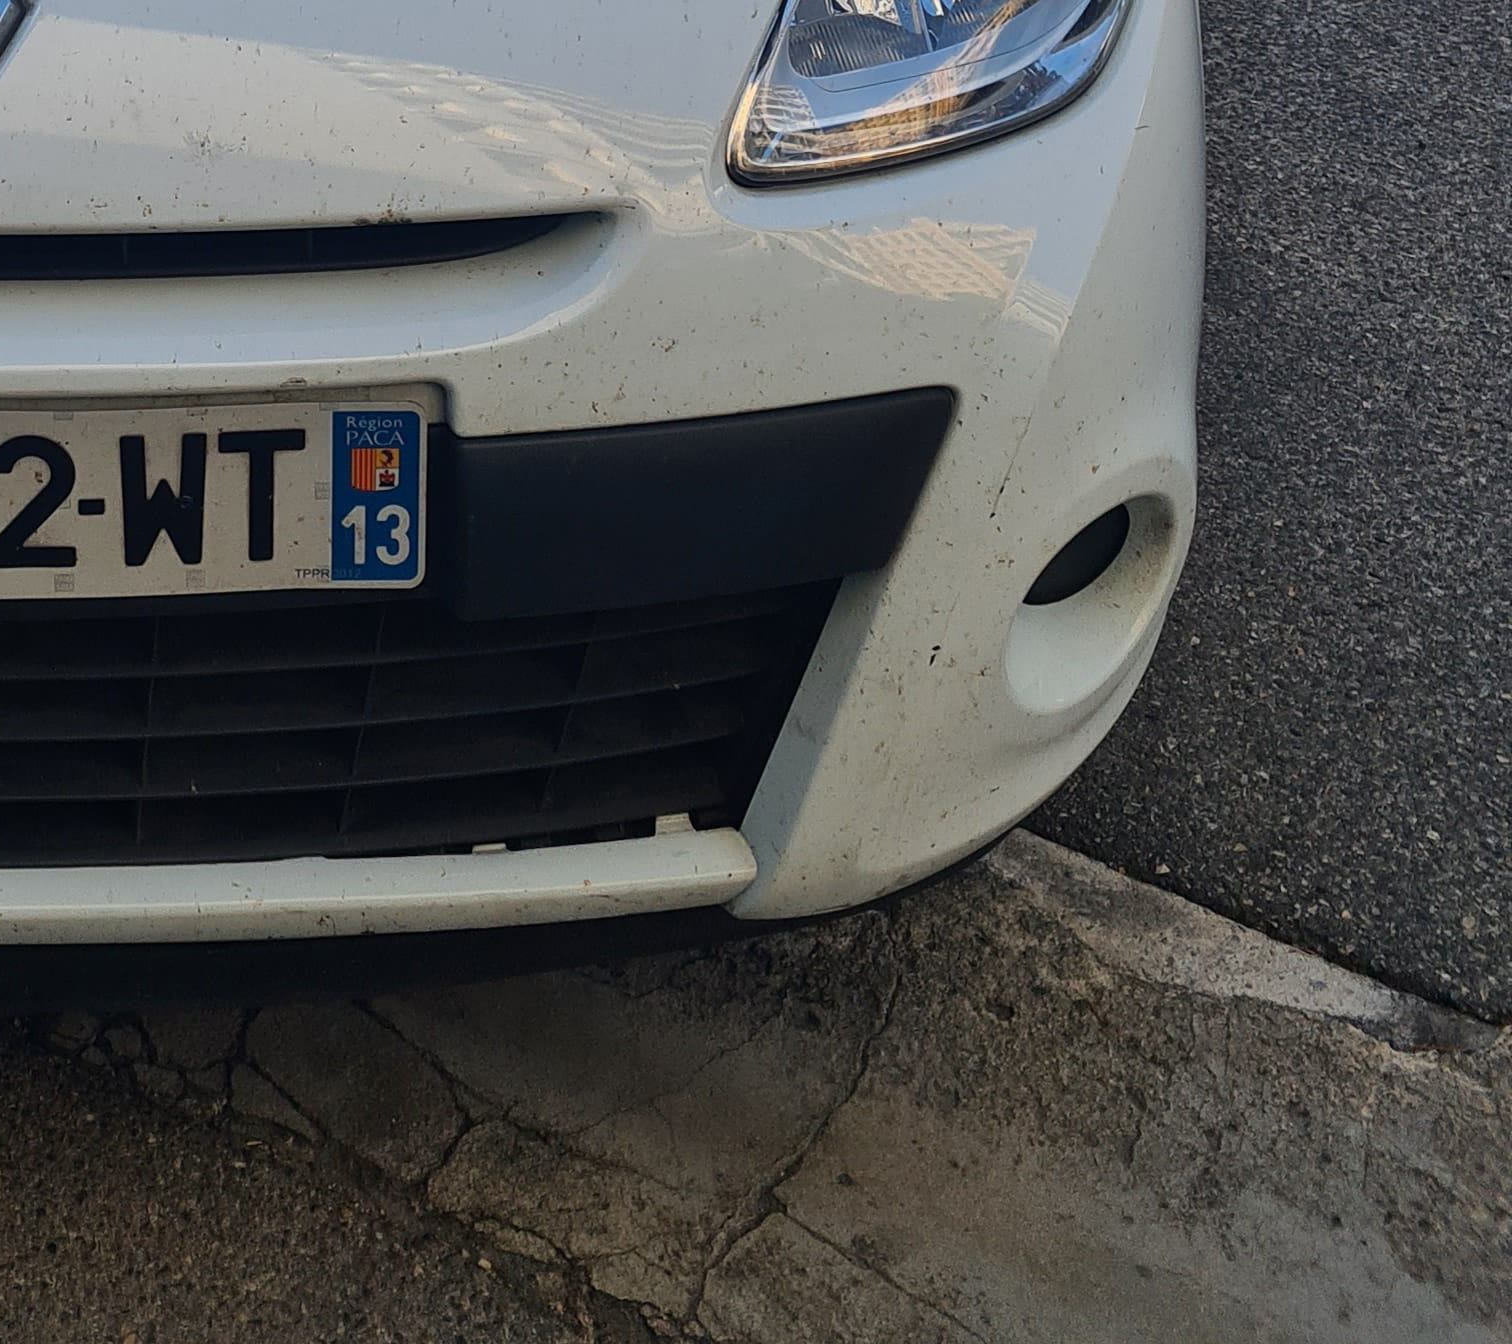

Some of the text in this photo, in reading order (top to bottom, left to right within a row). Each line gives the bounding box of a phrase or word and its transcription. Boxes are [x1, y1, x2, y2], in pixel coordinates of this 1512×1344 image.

[346, 415, 404, 431] Région
[345, 430, 405, 446] PACA
[341, 503, 411, 566] 13
[295, 567, 330, 579] TPPR
